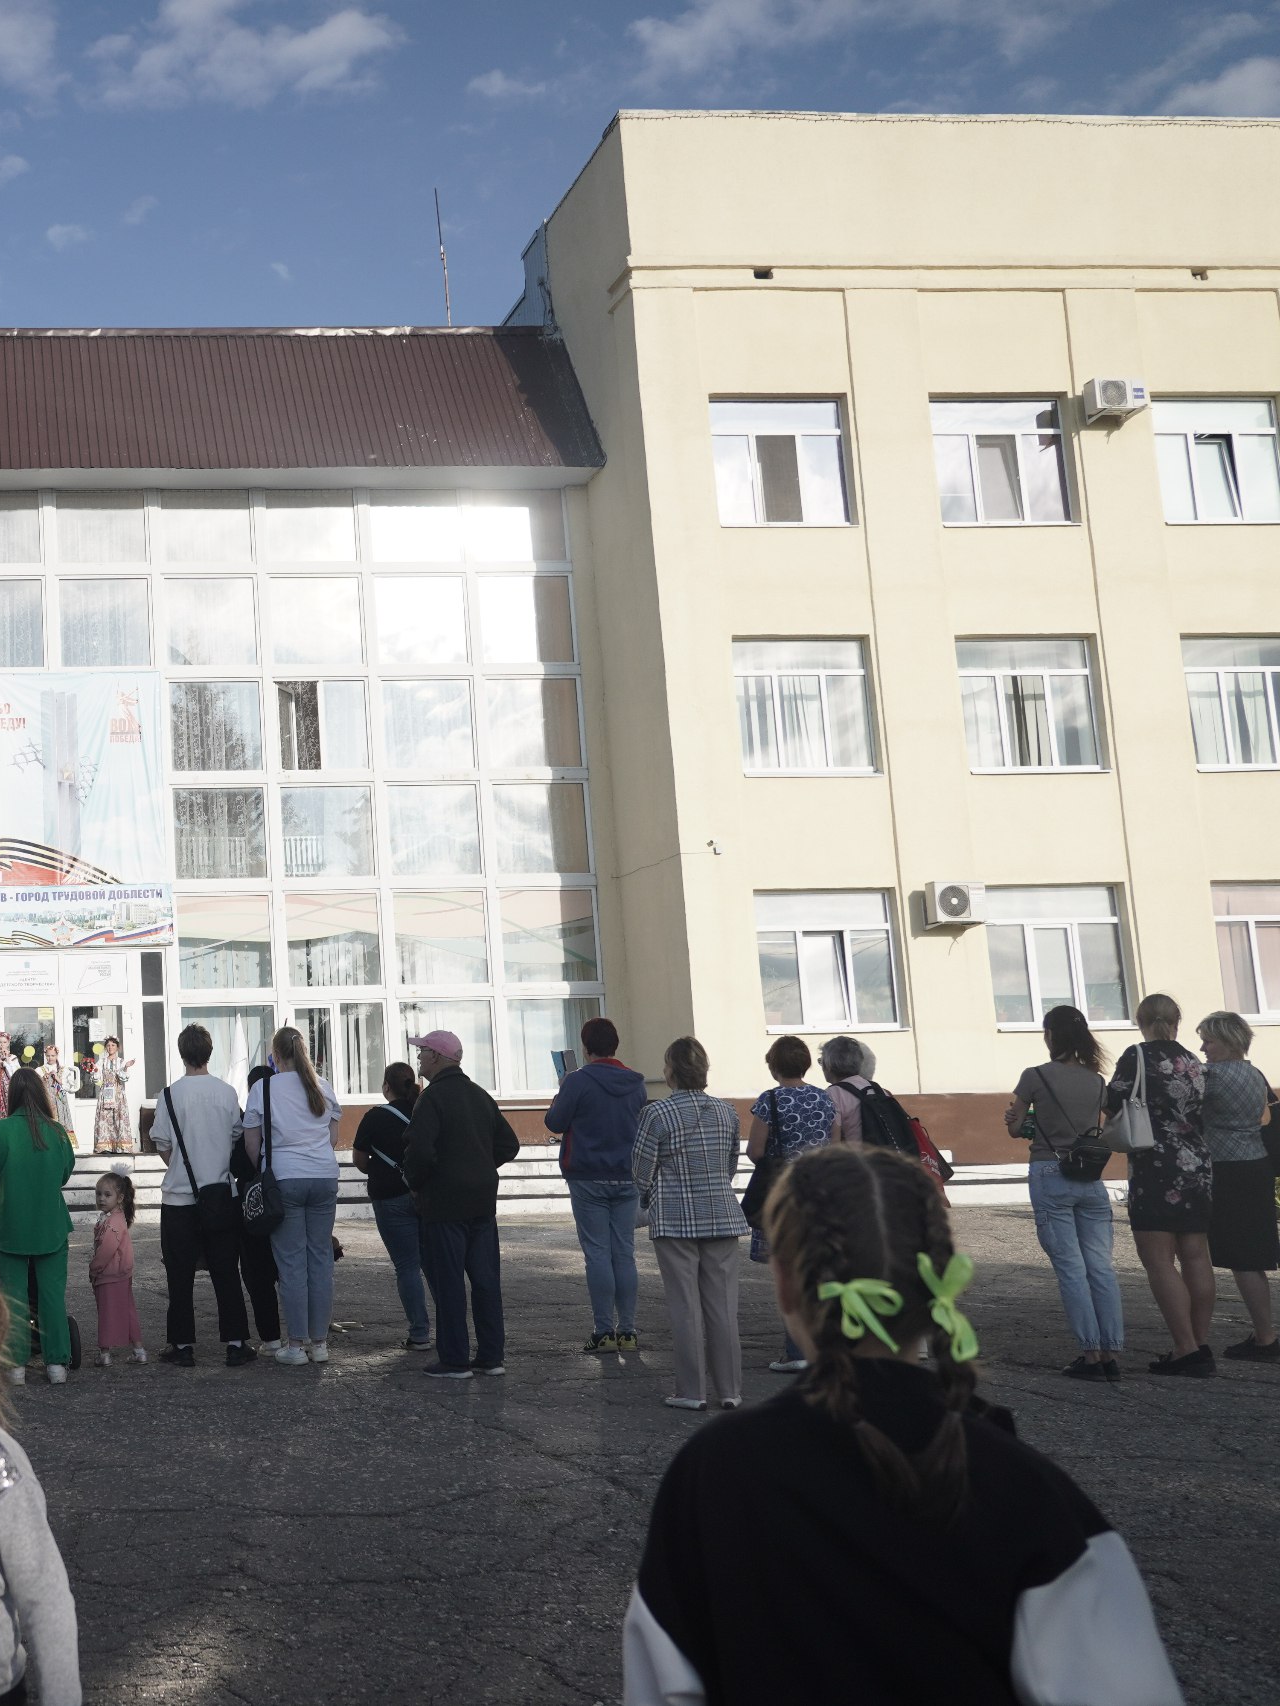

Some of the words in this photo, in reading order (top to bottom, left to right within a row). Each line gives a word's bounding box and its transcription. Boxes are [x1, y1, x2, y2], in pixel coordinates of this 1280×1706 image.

[15, 892, 50, 902] ГОРОД
[52, 889, 106, 902] ТРУДОВОЙ
[108, 888, 163, 900] ДОБЛЕСТИ
